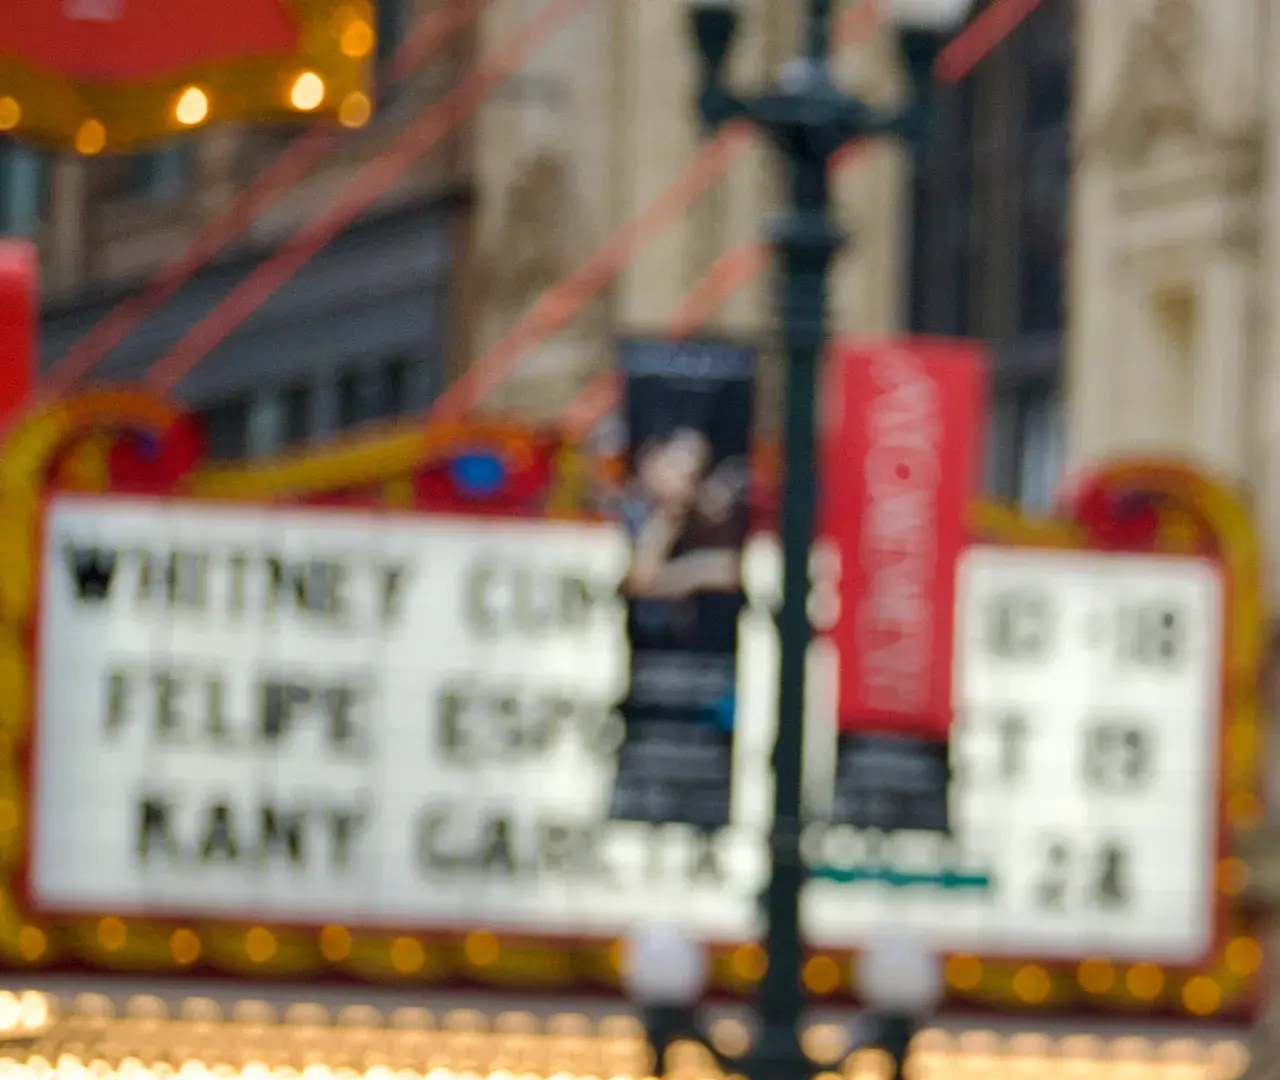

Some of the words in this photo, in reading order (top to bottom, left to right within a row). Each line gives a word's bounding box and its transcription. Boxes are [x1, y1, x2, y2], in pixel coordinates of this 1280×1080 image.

[66, 540, 410, 622] WHITNEY
[102, 668, 376, 758] FELIPE
[134, 794, 368, 874] KANY
